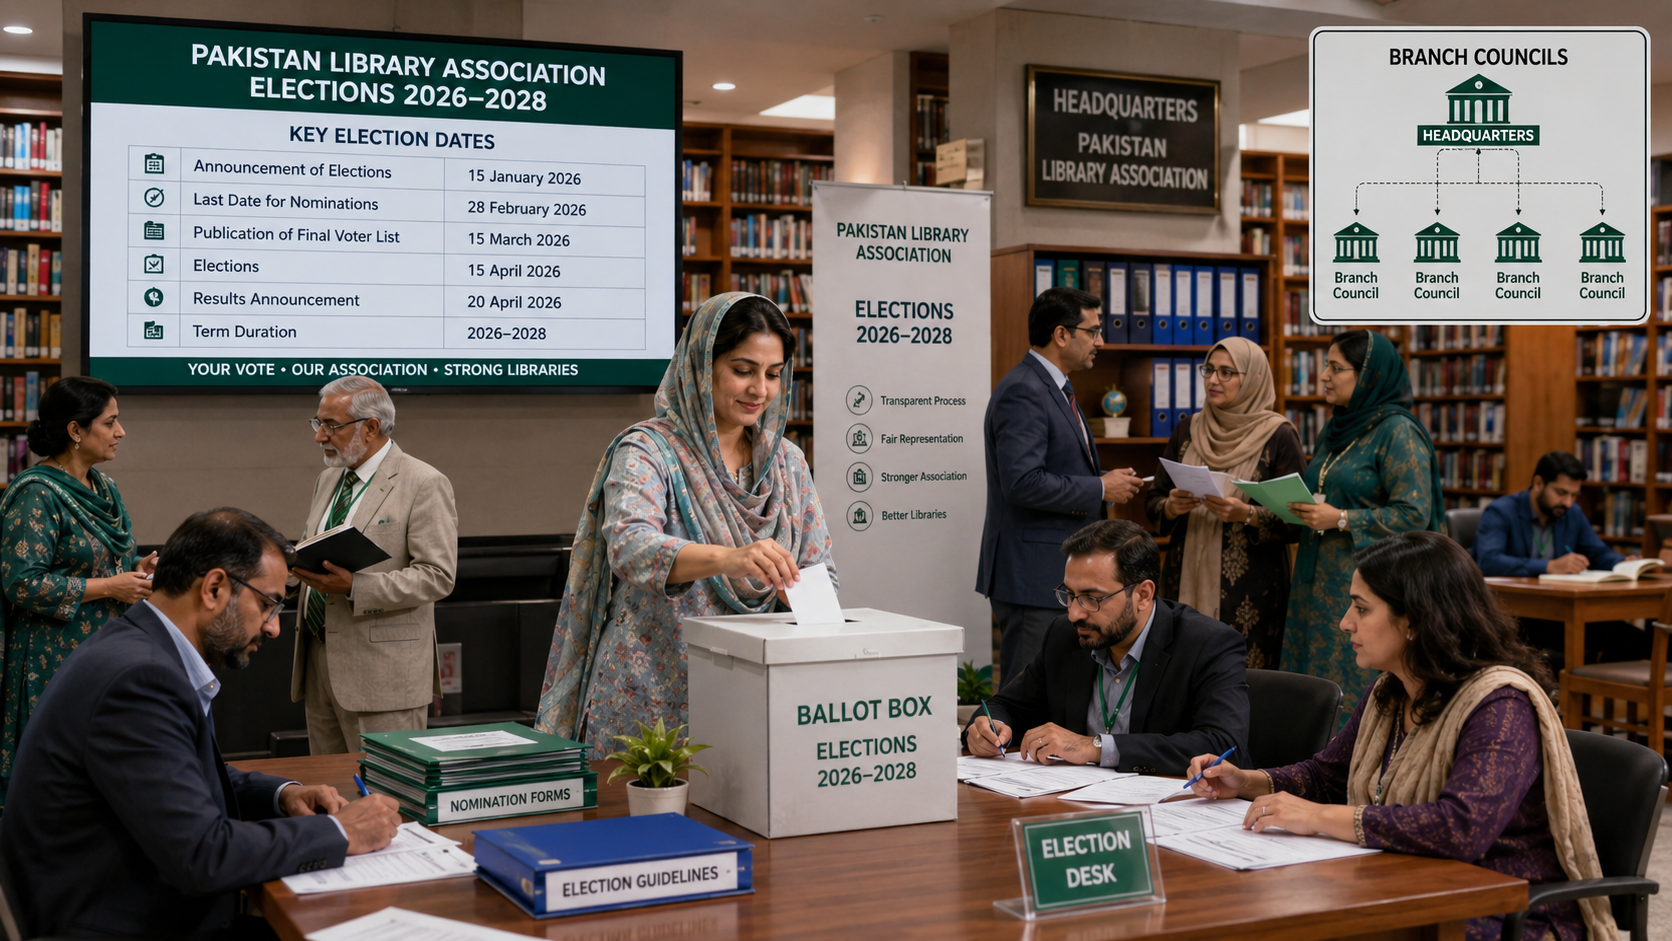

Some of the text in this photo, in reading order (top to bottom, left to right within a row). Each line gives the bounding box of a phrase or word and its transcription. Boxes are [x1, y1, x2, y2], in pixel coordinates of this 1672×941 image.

[192, 43, 605, 86] PAKISTAN LIBRARY ASSOCIATION
[250, 76, 546, 111] ELECTIONS 2026–2028
[1054, 88, 1198, 122] HEADQUARTERS
[290, 125, 494, 149] KEY ELECTION DATES
[1078, 132, 1166, 157] PAKISTAN
[193, 159, 391, 178] Announcement of Elections
[468, 168, 581, 186] 15 January 2026
[1042, 159, 1207, 189] LIBRARY ASSOCIATION
[194, 193, 378, 210] Last Date for Nominations
[467, 200, 586, 218] 28 February 2026
[193, 225, 399, 243] Publication of Final Voter List
[468, 232, 570, 246] 15 March 2026
[836, 221, 969, 242] PAKISTAN LIBRARY
[855, 244, 951, 263] ASSOCIATION
[193, 258, 259, 272] Elections
[468, 263, 560, 279] 15 April 2026
[193, 291, 359, 306] Results Announcement
[467, 295, 561, 311] 20 April 2026
[855, 299, 953, 319] ELECTIONS
[192, 324, 296, 338] Term Duration
[467, 326, 546, 339] 2026–2028
[856, 325, 952, 344] 2026–2028
[187, 362, 274, 375] YOUR VOTE
[291, 363, 428, 376] OUR ASSOCIATION
[444, 363, 578, 375] STRONG LIBRARIES
[880, 395, 966, 407] Transparent Process
[881, 433, 963, 445] Fair Representation
[880, 471, 967, 484] Stronger Association
[881, 509, 947, 520] Better Libraries
[797, 695, 932, 725] BALLOT BOX
[816, 734, 916, 760] ELECTIONS
[817, 761, 916, 787] 2026–2028
[450, 787, 570, 812] NOMINATION FORMS
[1041, 829, 1131, 858] ELECTION
[562, 865, 718, 897] ELECTION GUIDELINES
[1065, 862, 1118, 888] DESK
